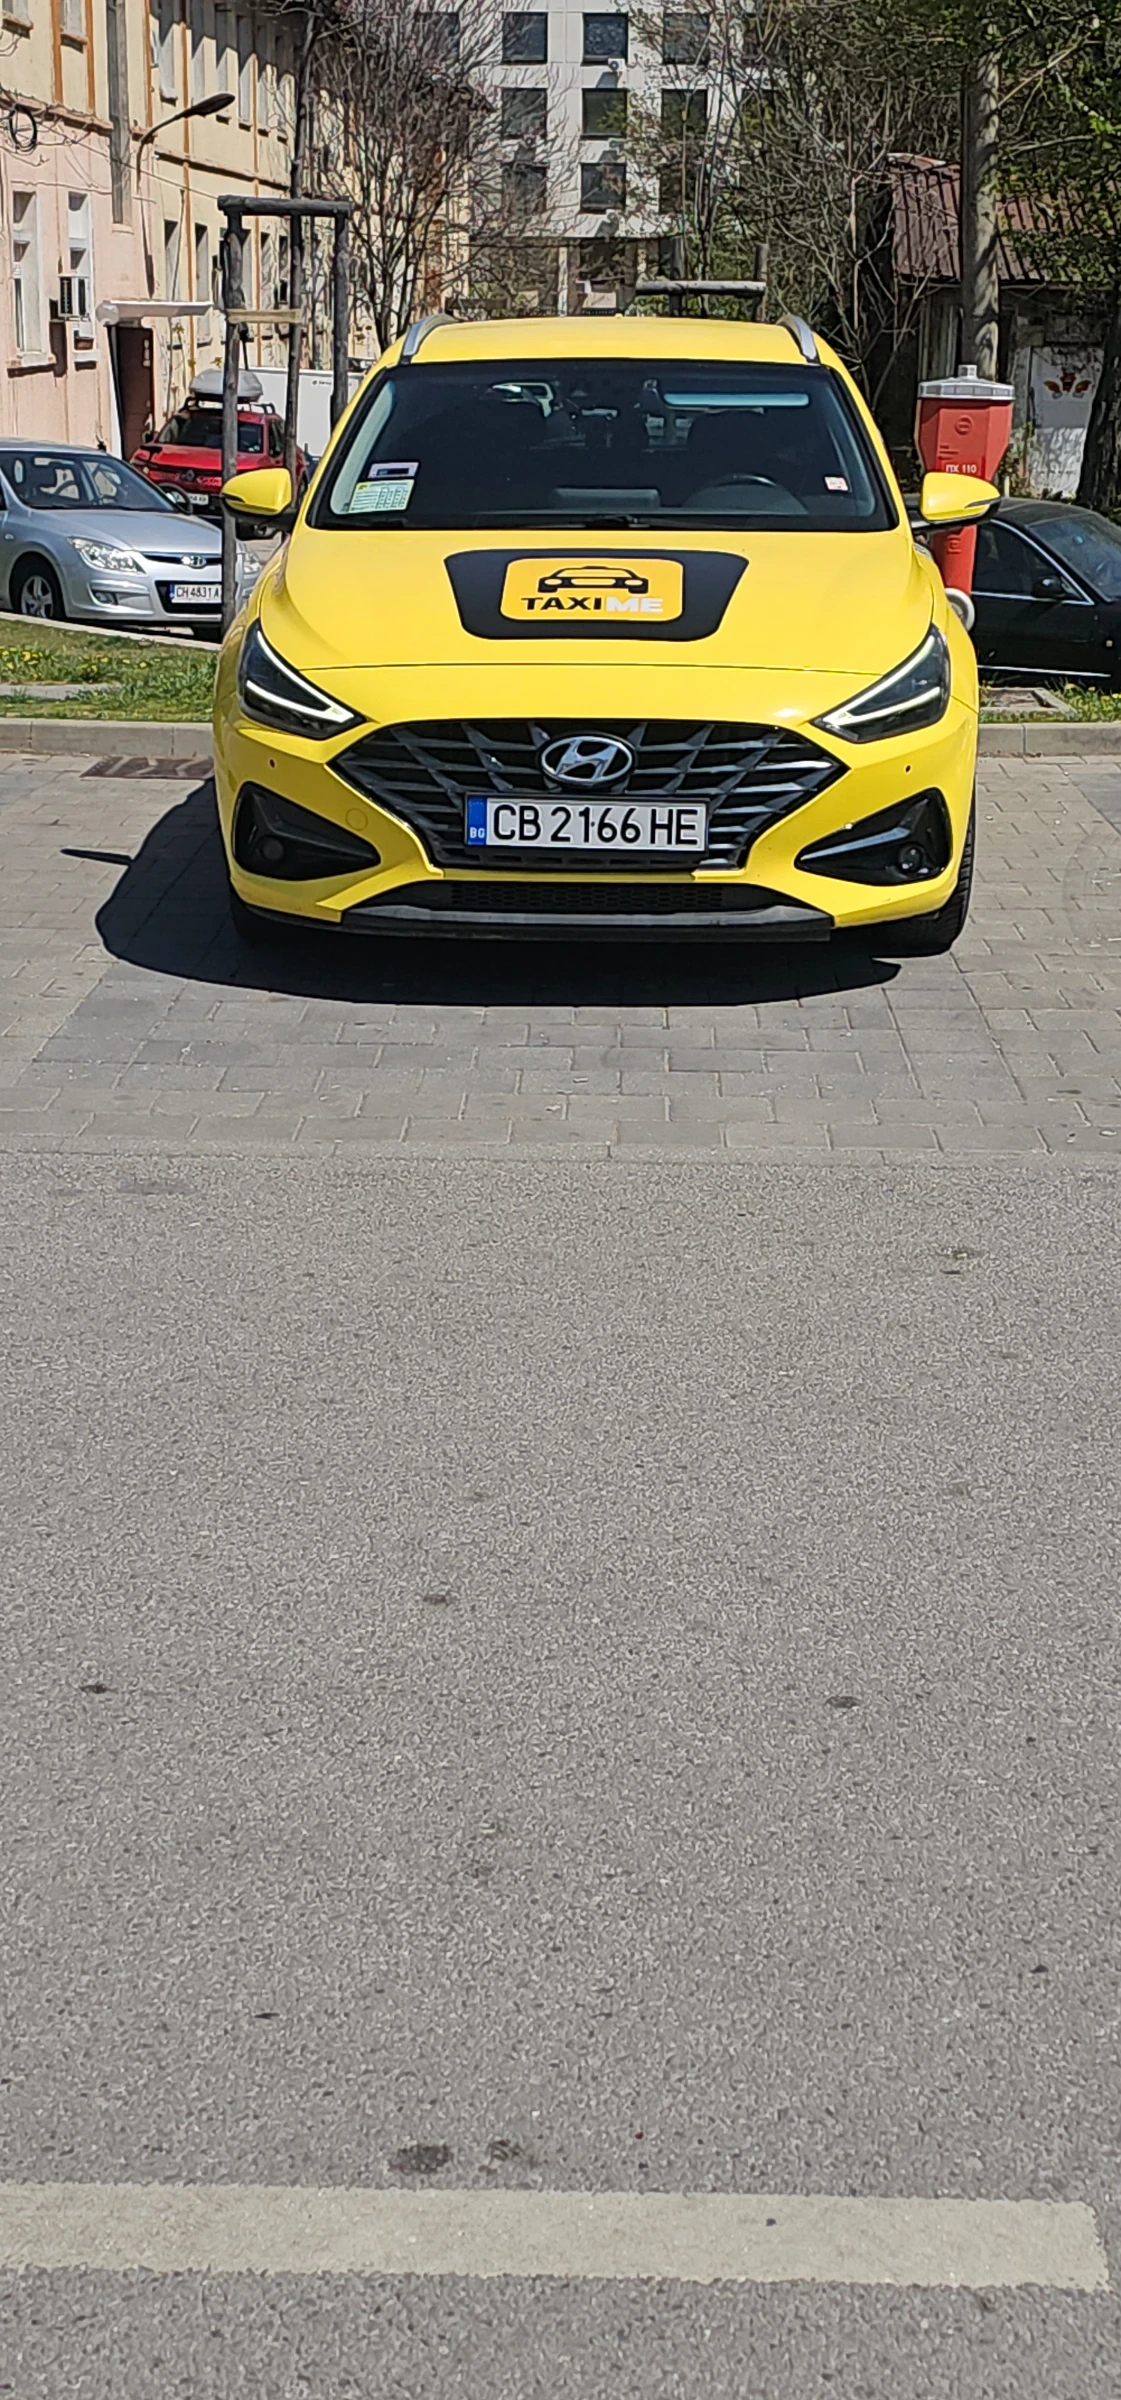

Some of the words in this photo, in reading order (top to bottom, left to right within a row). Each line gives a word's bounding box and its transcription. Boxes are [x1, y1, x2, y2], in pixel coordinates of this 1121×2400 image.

[962, 464, 977, 474] 110
[494, 804, 542, 841] CB
[550, 806, 642, 843] 2166
[649, 808, 699, 845] HE
[469, 827, 485, 838] BG
